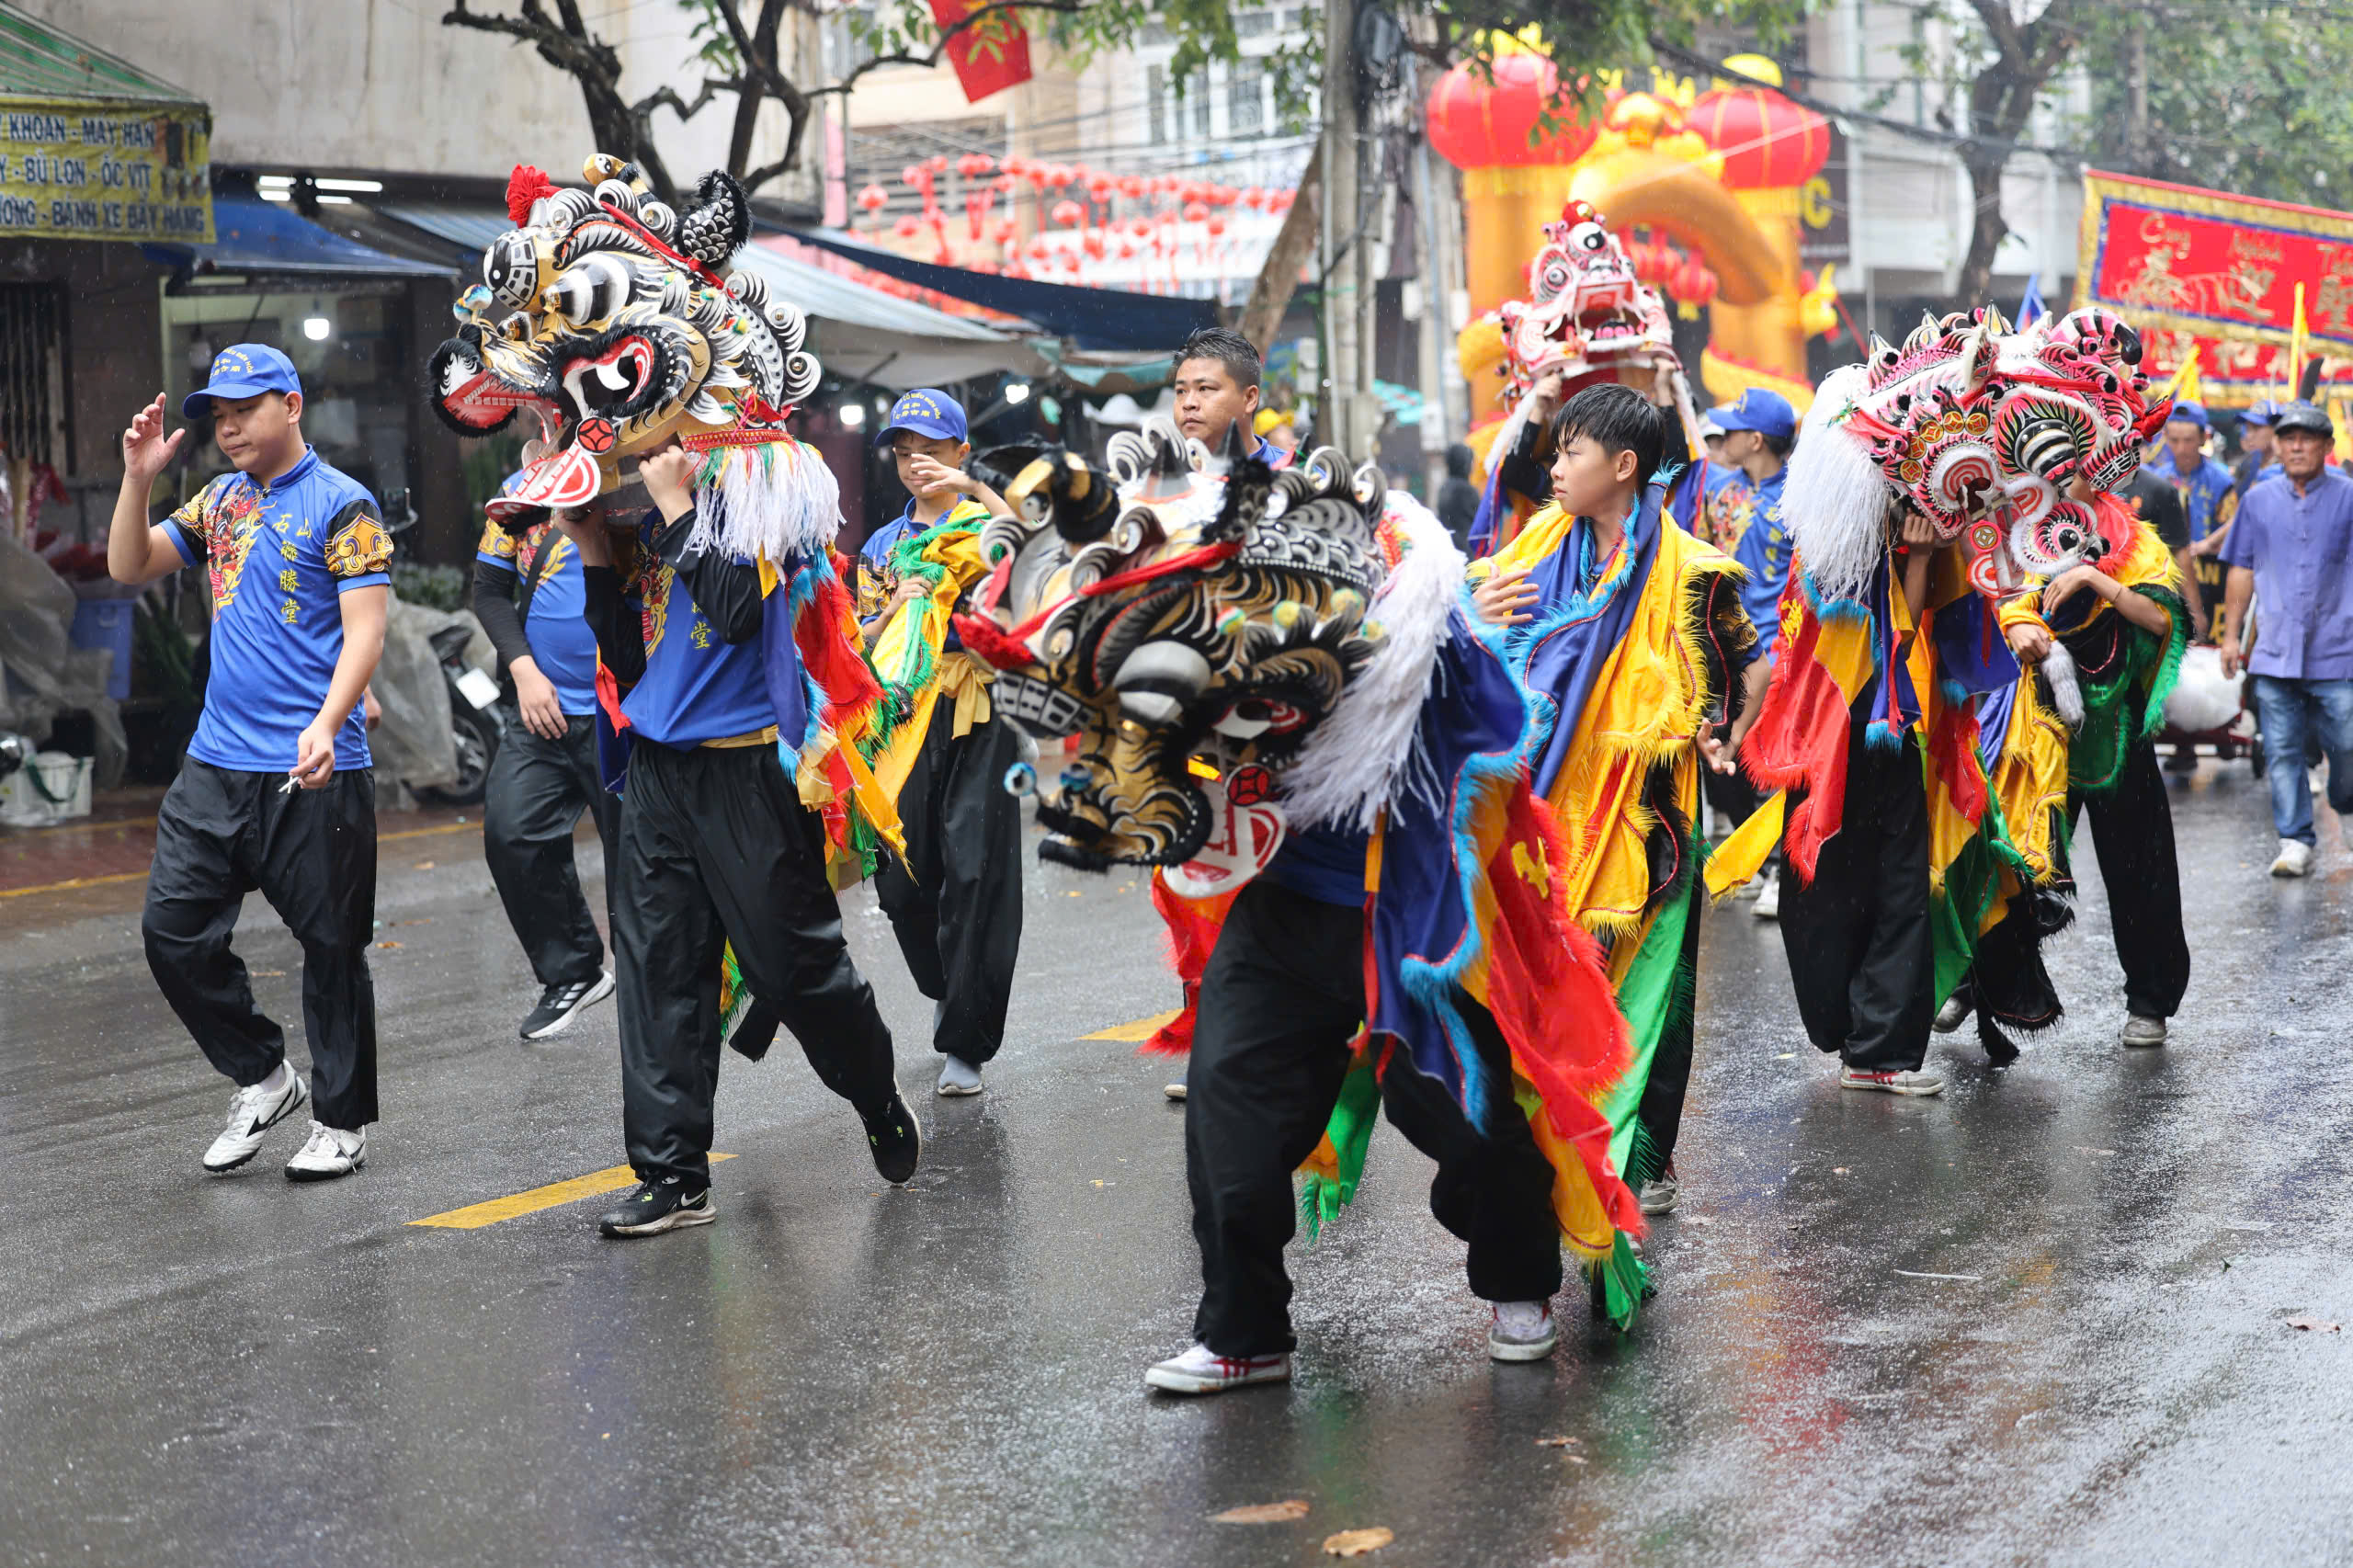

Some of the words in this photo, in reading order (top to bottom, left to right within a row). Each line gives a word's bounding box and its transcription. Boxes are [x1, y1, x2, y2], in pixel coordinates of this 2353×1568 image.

[9, 113, 65, 141] KHOAN
[55, 158, 85, 185] LON
[103, 202, 121, 227] XE
